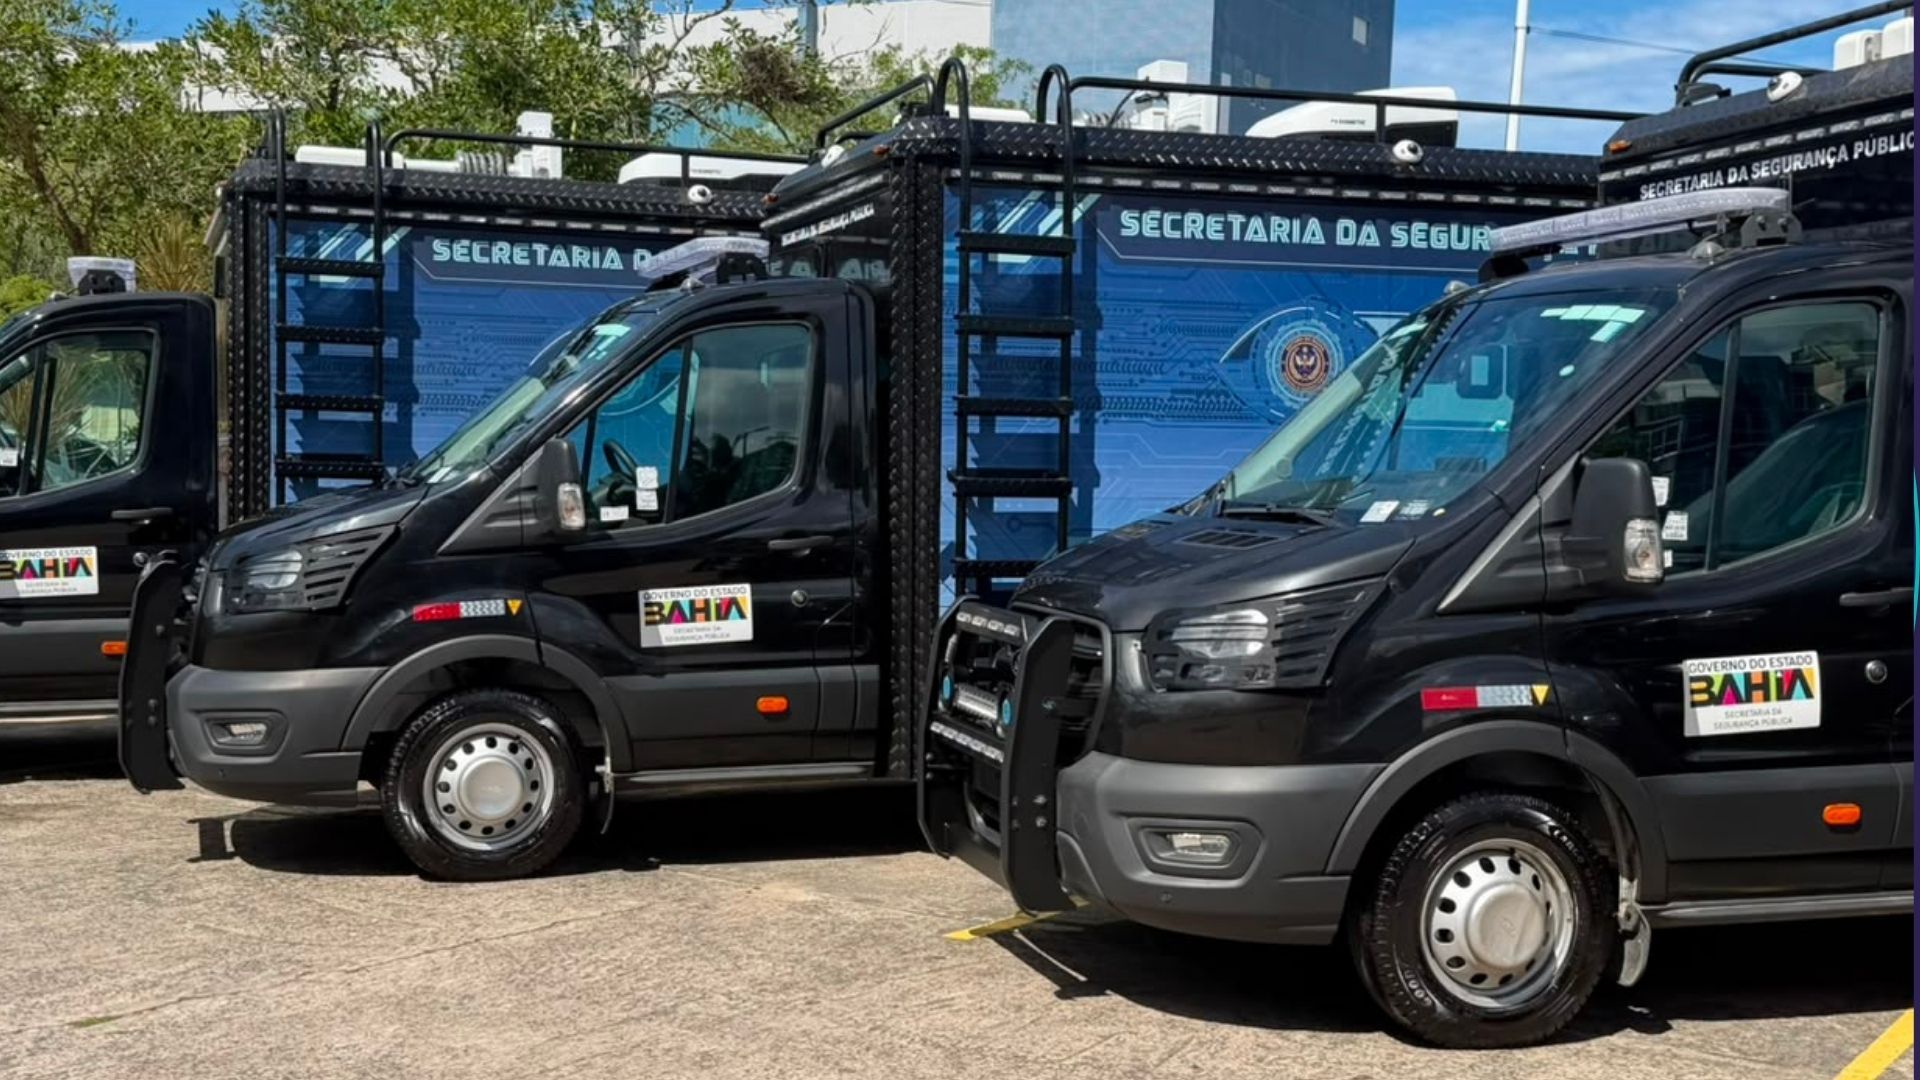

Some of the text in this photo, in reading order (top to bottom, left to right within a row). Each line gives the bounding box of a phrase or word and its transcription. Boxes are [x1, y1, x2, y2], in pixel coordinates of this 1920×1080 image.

[1640, 131, 1914, 200] SECRETARIA DA SEGURANÇA PÚBLIC
[1120, 210, 1491, 251] SECRETARIA DA SEGUR
[432, 239, 624, 271] SECRETARIA
[643, 586, 747, 601] GOVERNO DO ESTADO
[644, 597, 747, 627] BAHIA
[1689, 655, 1813, 674] GOVERNO DO ESTADO
[1689, 668, 1815, 708] BAHIA
